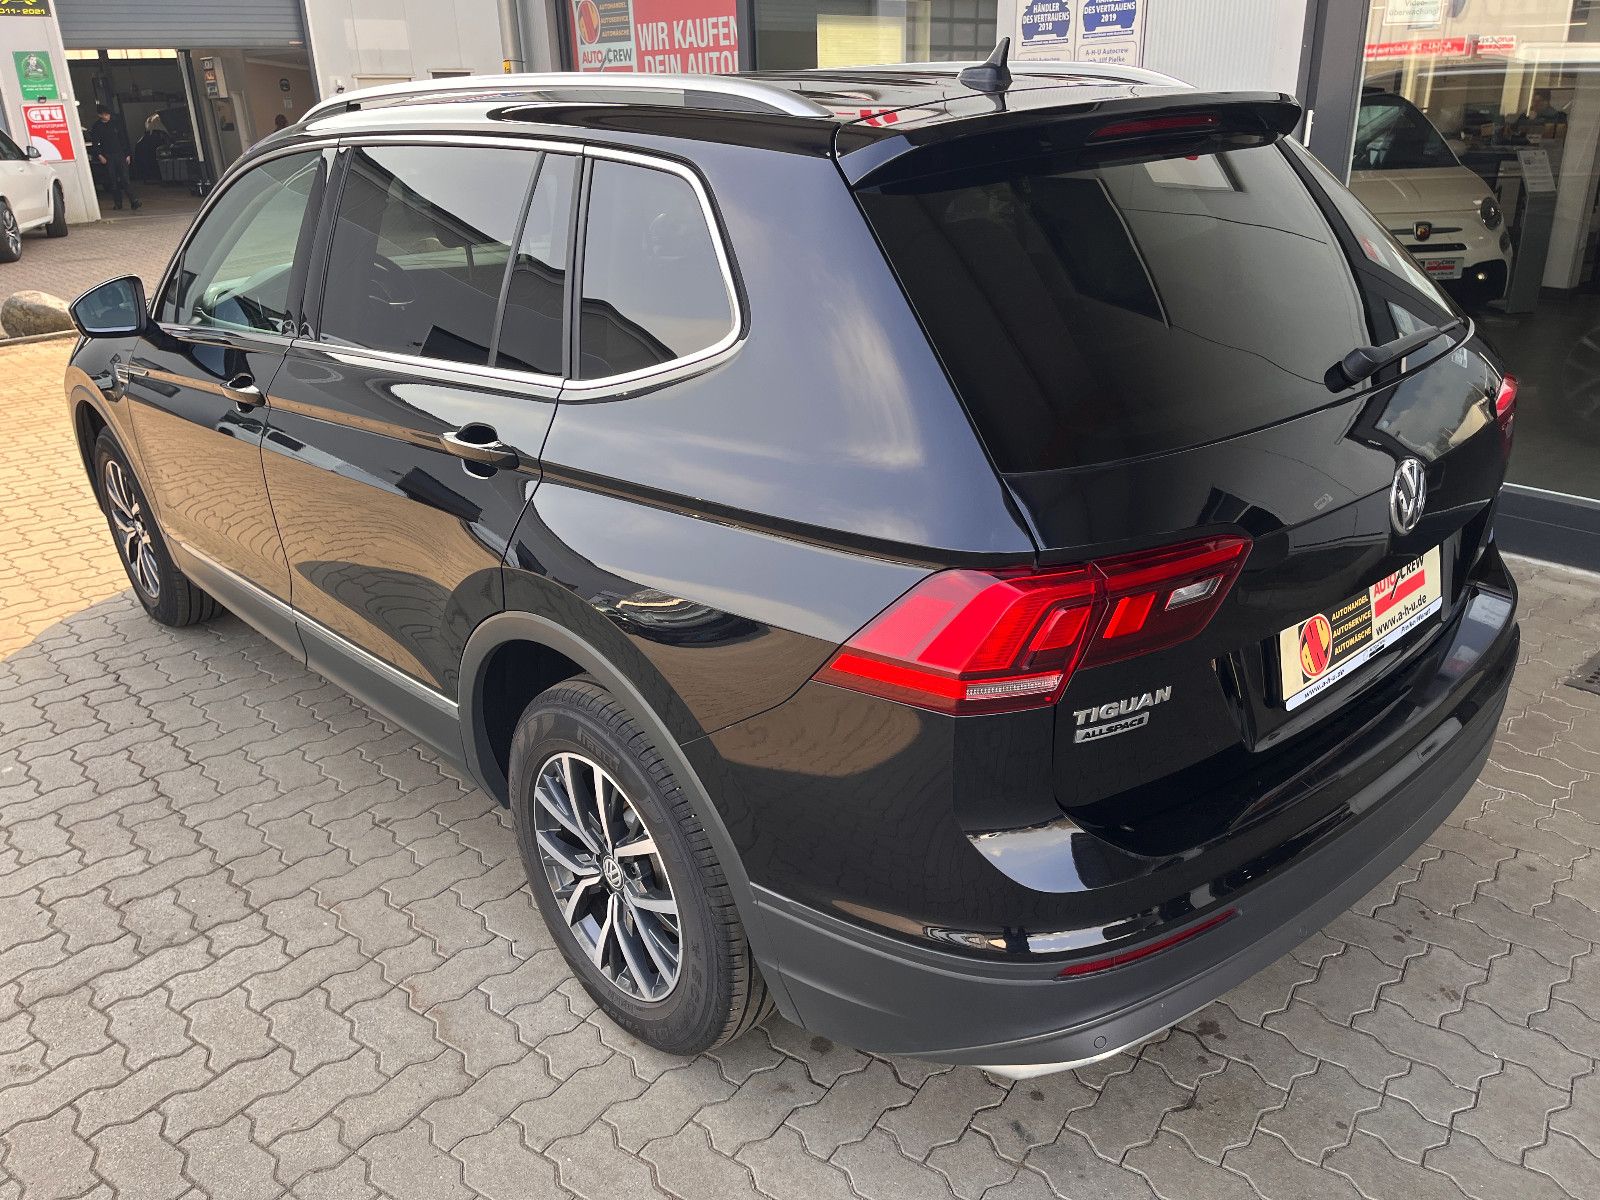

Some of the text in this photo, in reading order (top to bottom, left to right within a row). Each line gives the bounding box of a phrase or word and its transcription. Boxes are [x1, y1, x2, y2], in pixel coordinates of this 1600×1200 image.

[1023, 12, 1070, 24] DES VERTRAUENS
[1033, 3, 1060, 13] HÄNDLER
[1084, 2, 1136, 14] DES VERTRAUENS
[1101, 13, 1117, 23] 2019
[637, 22, 670, 51] WIR
[1038, 22, 1053, 31] 2018
[644, 53, 682, 73] DEIN
[1331, 594, 1369, 622] AUTOHANDEL
[1375, 594, 1427, 636] www.a-h-u.de
[1332, 611, 1372, 639] AUTOSERVICE
[1073, 685, 1172, 726] TIGUAN
[1081, 716, 1146, 740] ALLSPACE
